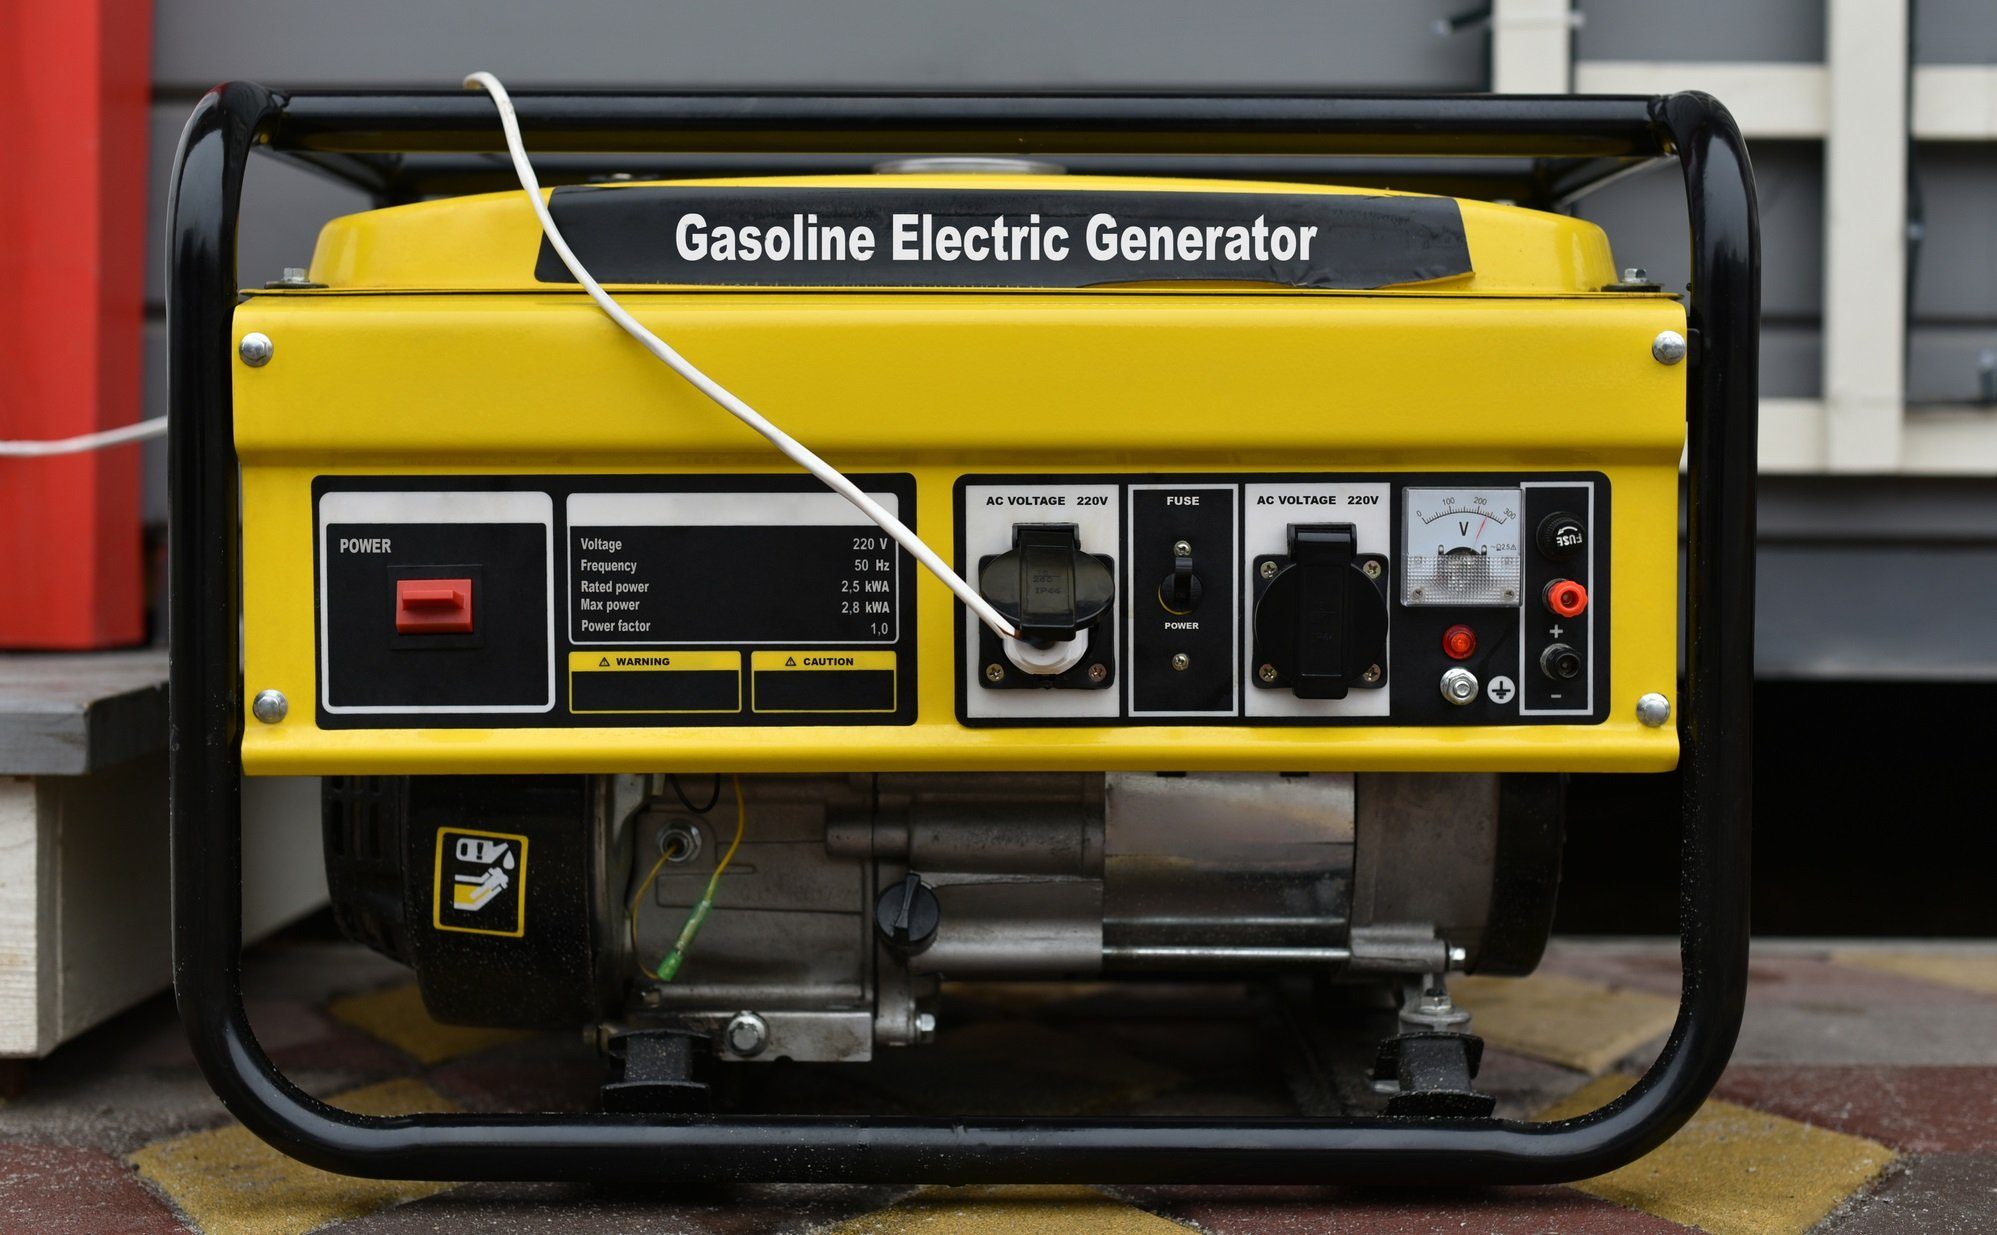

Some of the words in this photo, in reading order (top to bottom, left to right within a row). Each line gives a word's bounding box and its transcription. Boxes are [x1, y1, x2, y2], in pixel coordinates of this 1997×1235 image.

[676, 213, 875, 261] Gasoline
[893, 214, 1069, 261] Electric
[1086, 213, 1318, 261] Generator
[986, 497, 1003, 505] AC
[1008, 497, 1065, 505] VOLTAGE
[1077, 497, 1108, 505] 220V
[1167, 497, 1199, 505] FUSE
[1257, 496, 1274, 504] AC
[1278, 496, 1336, 504] VOLTAGE
[1348, 496, 1379, 504] 220V
[1442, 497, 1455, 505] 100
[1473, 496, 1487, 506] 200
[1503, 507, 1517, 519] 300
[1459, 522, 1468, 536] V
[340, 539, 391, 553] POWER
[581, 538, 622, 553] Voltage
[853, 538, 874, 549] 220
[880, 538, 887, 549] V
[1556, 533, 1583, 546] FUSE
[581, 559, 637, 574] Frequency
[855, 559, 868, 571] 50
[876, 559, 889, 571] Hz
[581, 581, 612, 592] Rated
[615, 582, 649, 596] power
[842, 580, 859, 593] 2,5
[866, 581, 889, 592] kWA
[581, 599, 603, 610] Max
[607, 601, 640, 613] power
[842, 602, 859, 615] 2,8
[866, 602, 889, 613] kWA
[582, 620, 615, 631] Power
[617, 620, 652, 631] factor
[871, 623, 888, 635] 1,0
[804, 658, 853, 666] CAUTION
